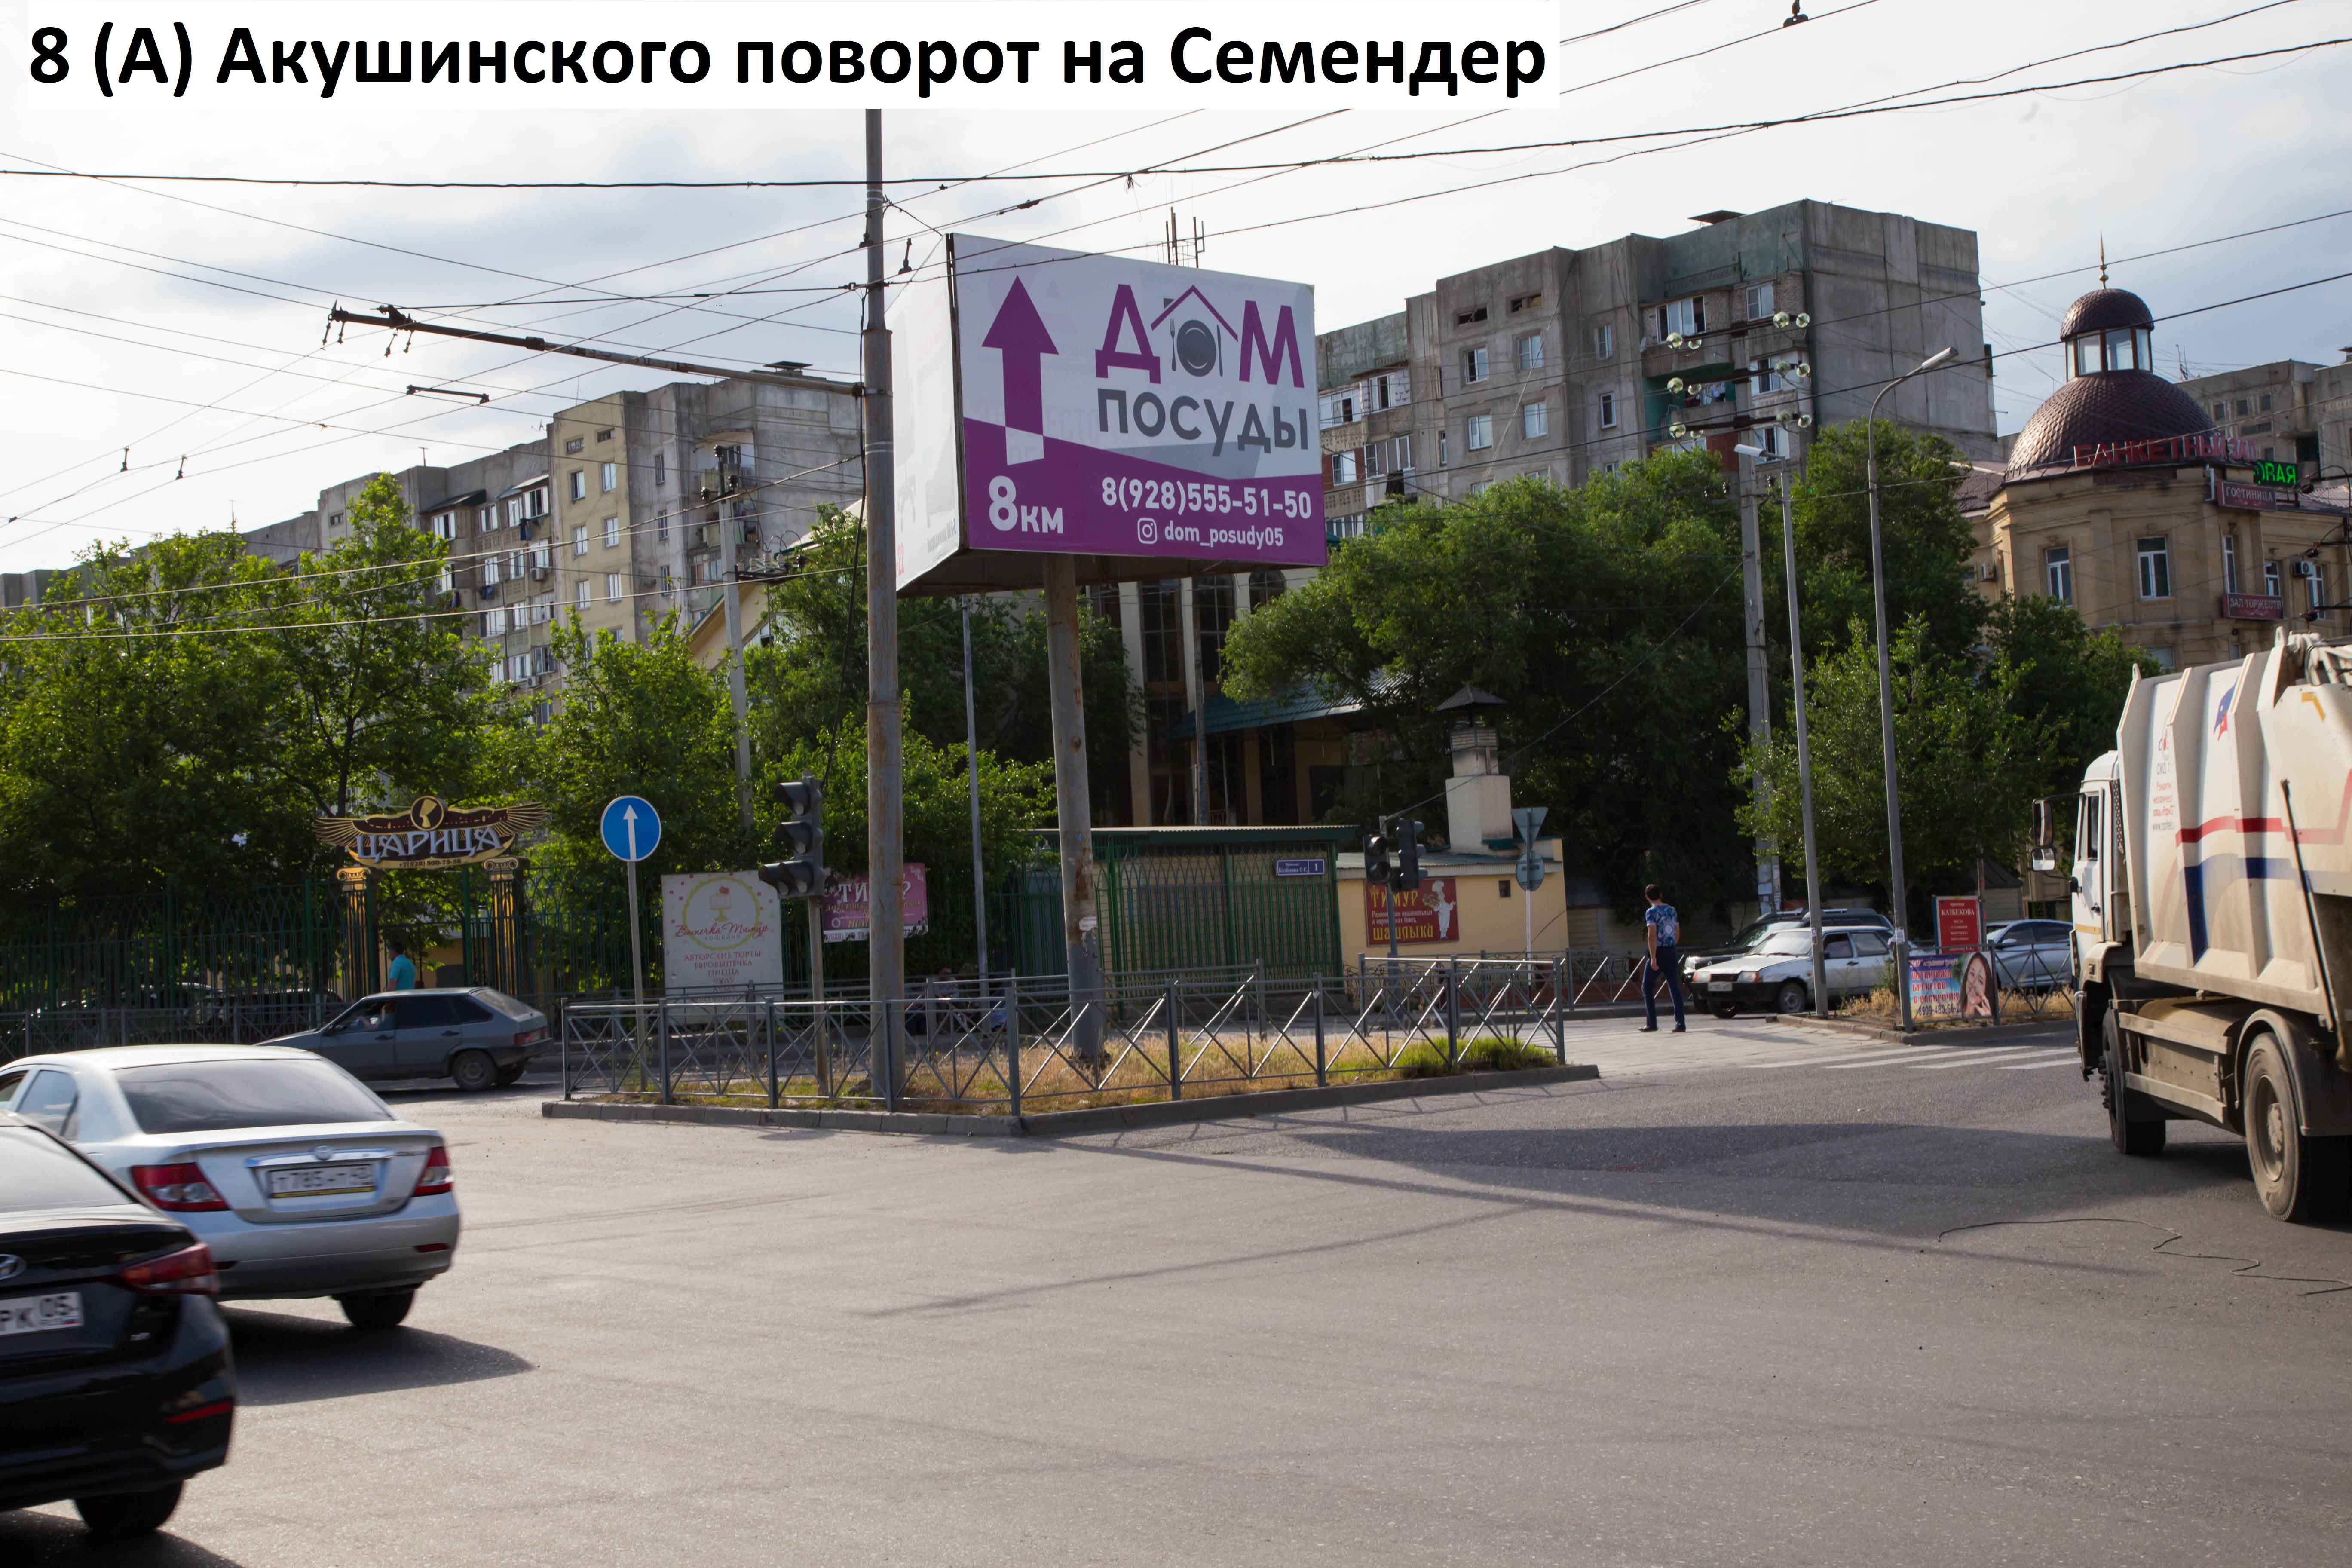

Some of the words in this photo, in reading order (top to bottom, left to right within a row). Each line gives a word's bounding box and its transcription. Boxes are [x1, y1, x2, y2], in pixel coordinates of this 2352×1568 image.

[2073, 432, 2227, 467] БАНКЕТНЫЙ
[1102, 476, 1311, 519] 8(928)555-51-50
[2226, 487, 2273, 502] ГОСТИНИЦА
[1164, 519, 1283, 551] dom_posudy05
[355, 827, 503, 864] ЦАРИЦА
[684, 952, 732, 962] АВТОРСКИЕ
[734, 950, 761, 959] ТОРТЫ
[708, 969, 740, 977] ПИЦЦА
